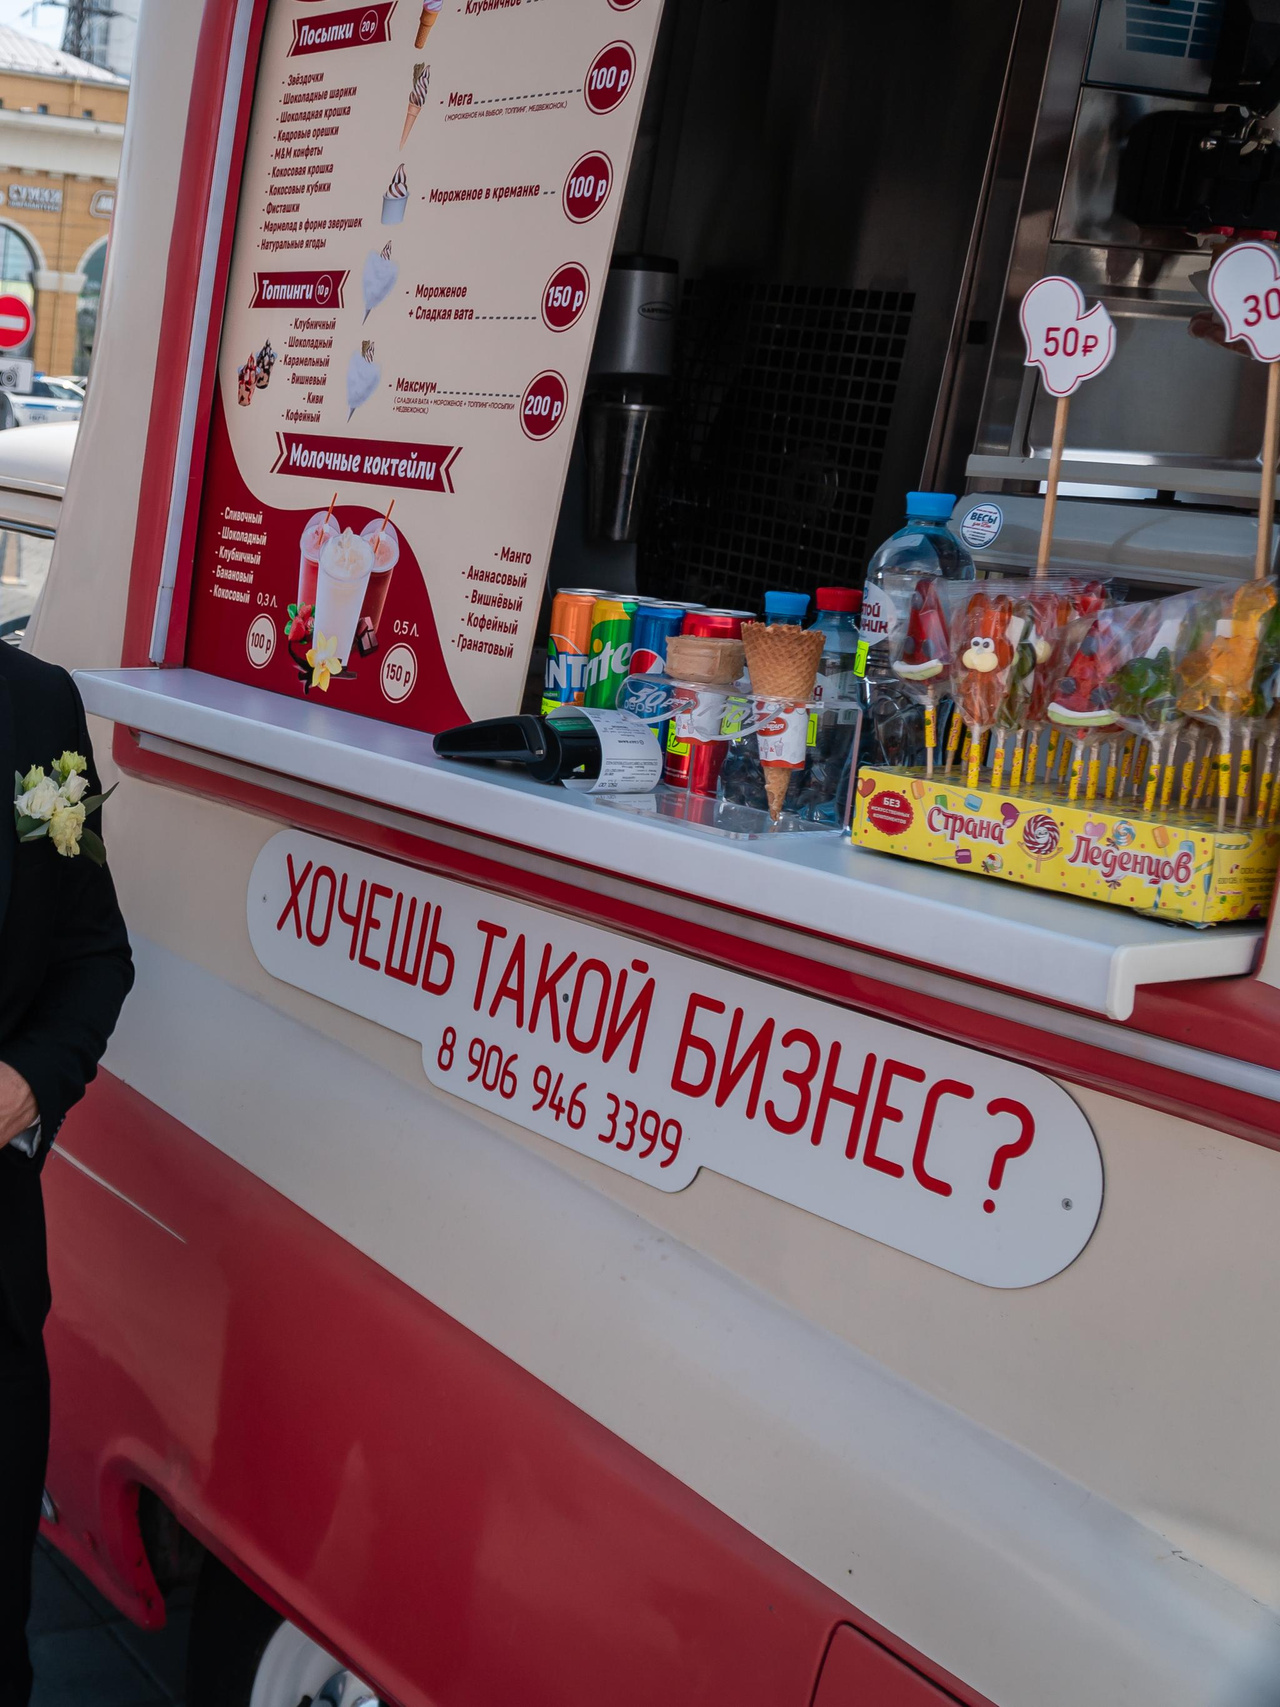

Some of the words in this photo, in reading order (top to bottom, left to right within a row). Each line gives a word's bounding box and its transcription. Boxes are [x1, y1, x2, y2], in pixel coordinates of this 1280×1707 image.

[299, 22, 354, 47] Посыпки
[361, 20, 371, 33] 20
[287, 72, 325, 86] Звёздочки
[590, 65, 617, 91] 100
[282, 90, 329, 105] Шоколадные
[329, 86, 358, 101] шарики
[448, 92, 473, 108] Мега
[280, 109, 323, 124] Шоколадная
[323, 106, 351, 120] крошка
[277, 129, 311, 143] Кедровые
[312, 126, 340, 140] орешки
[292, 145, 324, 160] конфеты
[271, 165, 307, 179] Кокосовая
[307, 163, 334, 177] крошка
[268, 184, 305, 197] Кокосовые
[306, 181, 332, 196] кубики
[429, 188, 483, 206] Мороженое
[484, 187, 491, 200] в
[492, 184, 541, 202] креманке
[569, 175, 595, 199] 100
[266, 201, 301, 215] Фисташки
[263, 220, 298, 235] Мармелад
[304, 218, 327, 233] форме
[327, 217, 363, 232] зверушек
[260, 238, 305, 253] Натуральные
[305, 238, 327, 251] ягоды
[262, 279, 314, 301] Топпинги
[415, 284, 468, 301] Мороженое
[547, 285, 572, 307] 150
[415, 306, 452, 321] Сладкая
[453, 307, 474, 320] вата
[293, 317, 337, 332] Клубничный
[288, 336, 334, 350] Шоколадный
[283, 354, 331, 369] Карамельный
[291, 372, 327, 386] Вишневый
[395, 377, 437, 396] Максмум
[306, 391, 324, 405] Киви
[524, 395, 551, 415] 200
[285, 408, 321, 424] Кофейный
[289, 442, 362, 474] Молочные
[362, 451, 437, 481] коктейли
[224, 506, 263, 525] Сливочный
[970, 511, 998, 525] ВЕСЫ
[221, 526, 267, 546] Шоколадный
[218, 545, 262, 565] Клубничный
[500, 546, 532, 565] Манго
[215, 564, 254, 585] Банановый
[466, 565, 528, 589] Ананасовый
[212, 584, 251, 604] Кокосовый
[470, 589, 523, 612] Вишнёвый
[393, 619, 409, 635] 0,5
[466, 612, 519, 635] Кофейный
[250, 631, 265, 649] 100
[457, 633, 514, 659] Гранатовый
[386, 662, 403, 682] 150
[883, 797, 901, 808] БЕЗ
[927, 806, 1005, 845] Страна
[1068, 835, 1192, 885] Леденцов
[276, 852, 456, 997] ХОЧЕШЬ
[468, 919, 656, 1075] ТАКОЙ
[437, 1026, 456, 1072] 8
[466, 1037, 518, 1101] 906
[531, 1064, 587, 1132] 946
[597, 1091, 683, 1169] 3399
